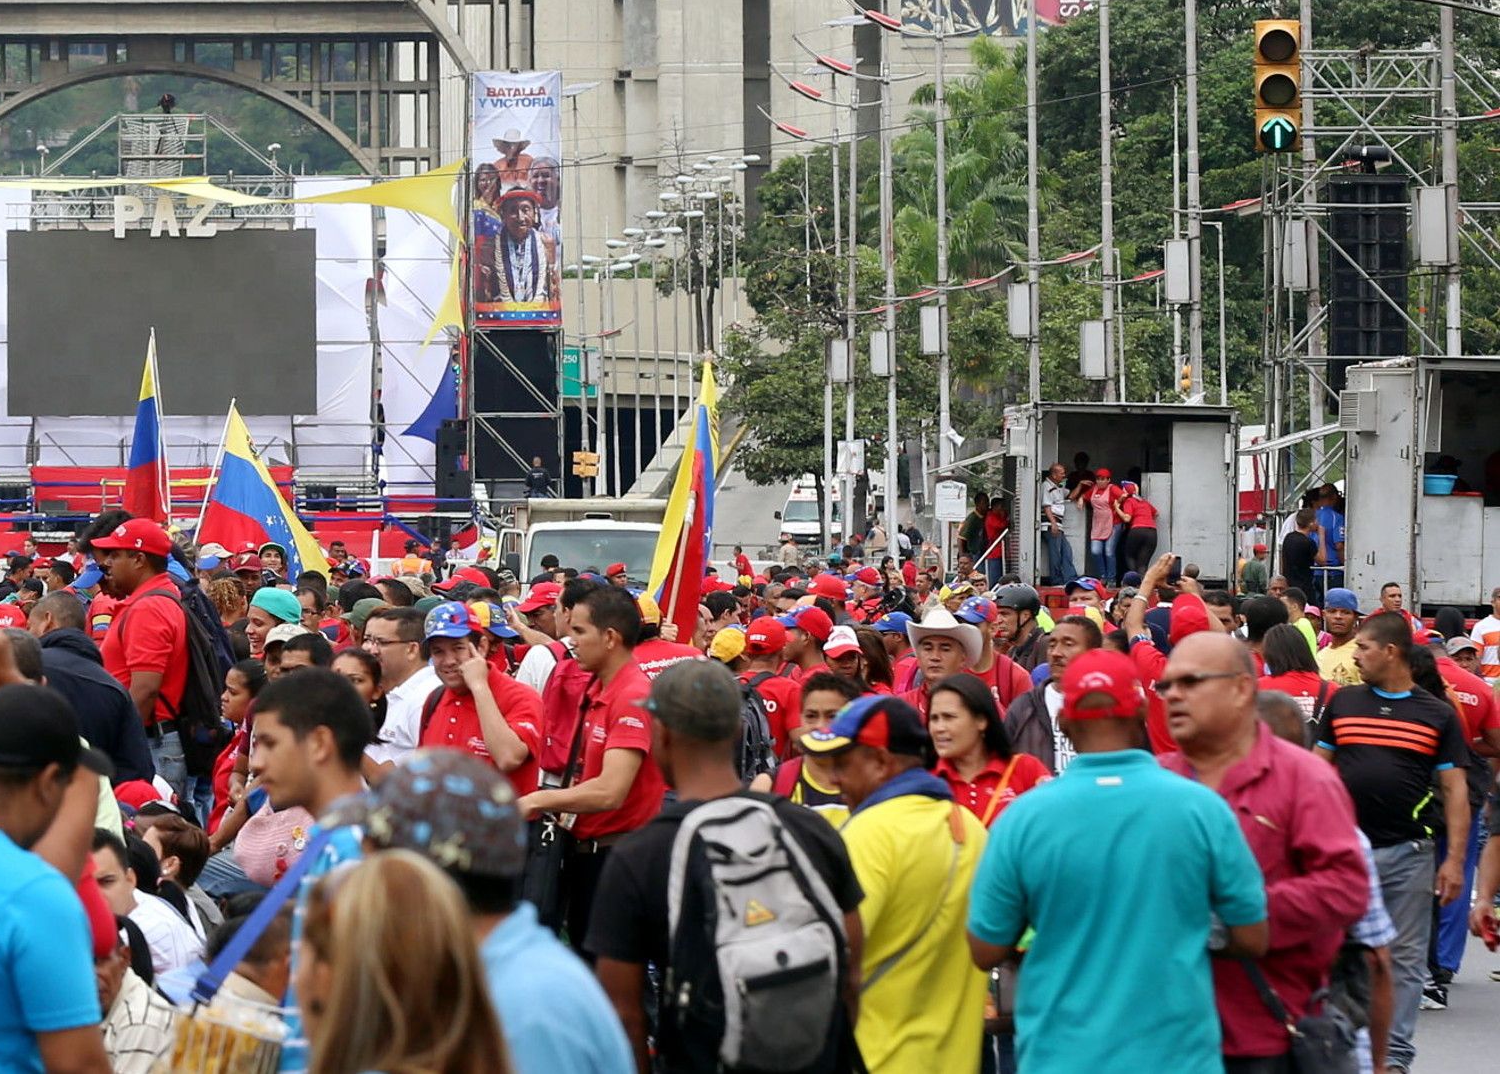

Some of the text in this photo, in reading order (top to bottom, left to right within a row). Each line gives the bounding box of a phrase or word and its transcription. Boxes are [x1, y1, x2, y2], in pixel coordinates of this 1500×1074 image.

[486, 86, 547, 97] BATALLA
[478, 97, 556, 108] Y VICTORIA
[114, 194, 218, 239] PAZ
[134, 538, 143, 548] 3
